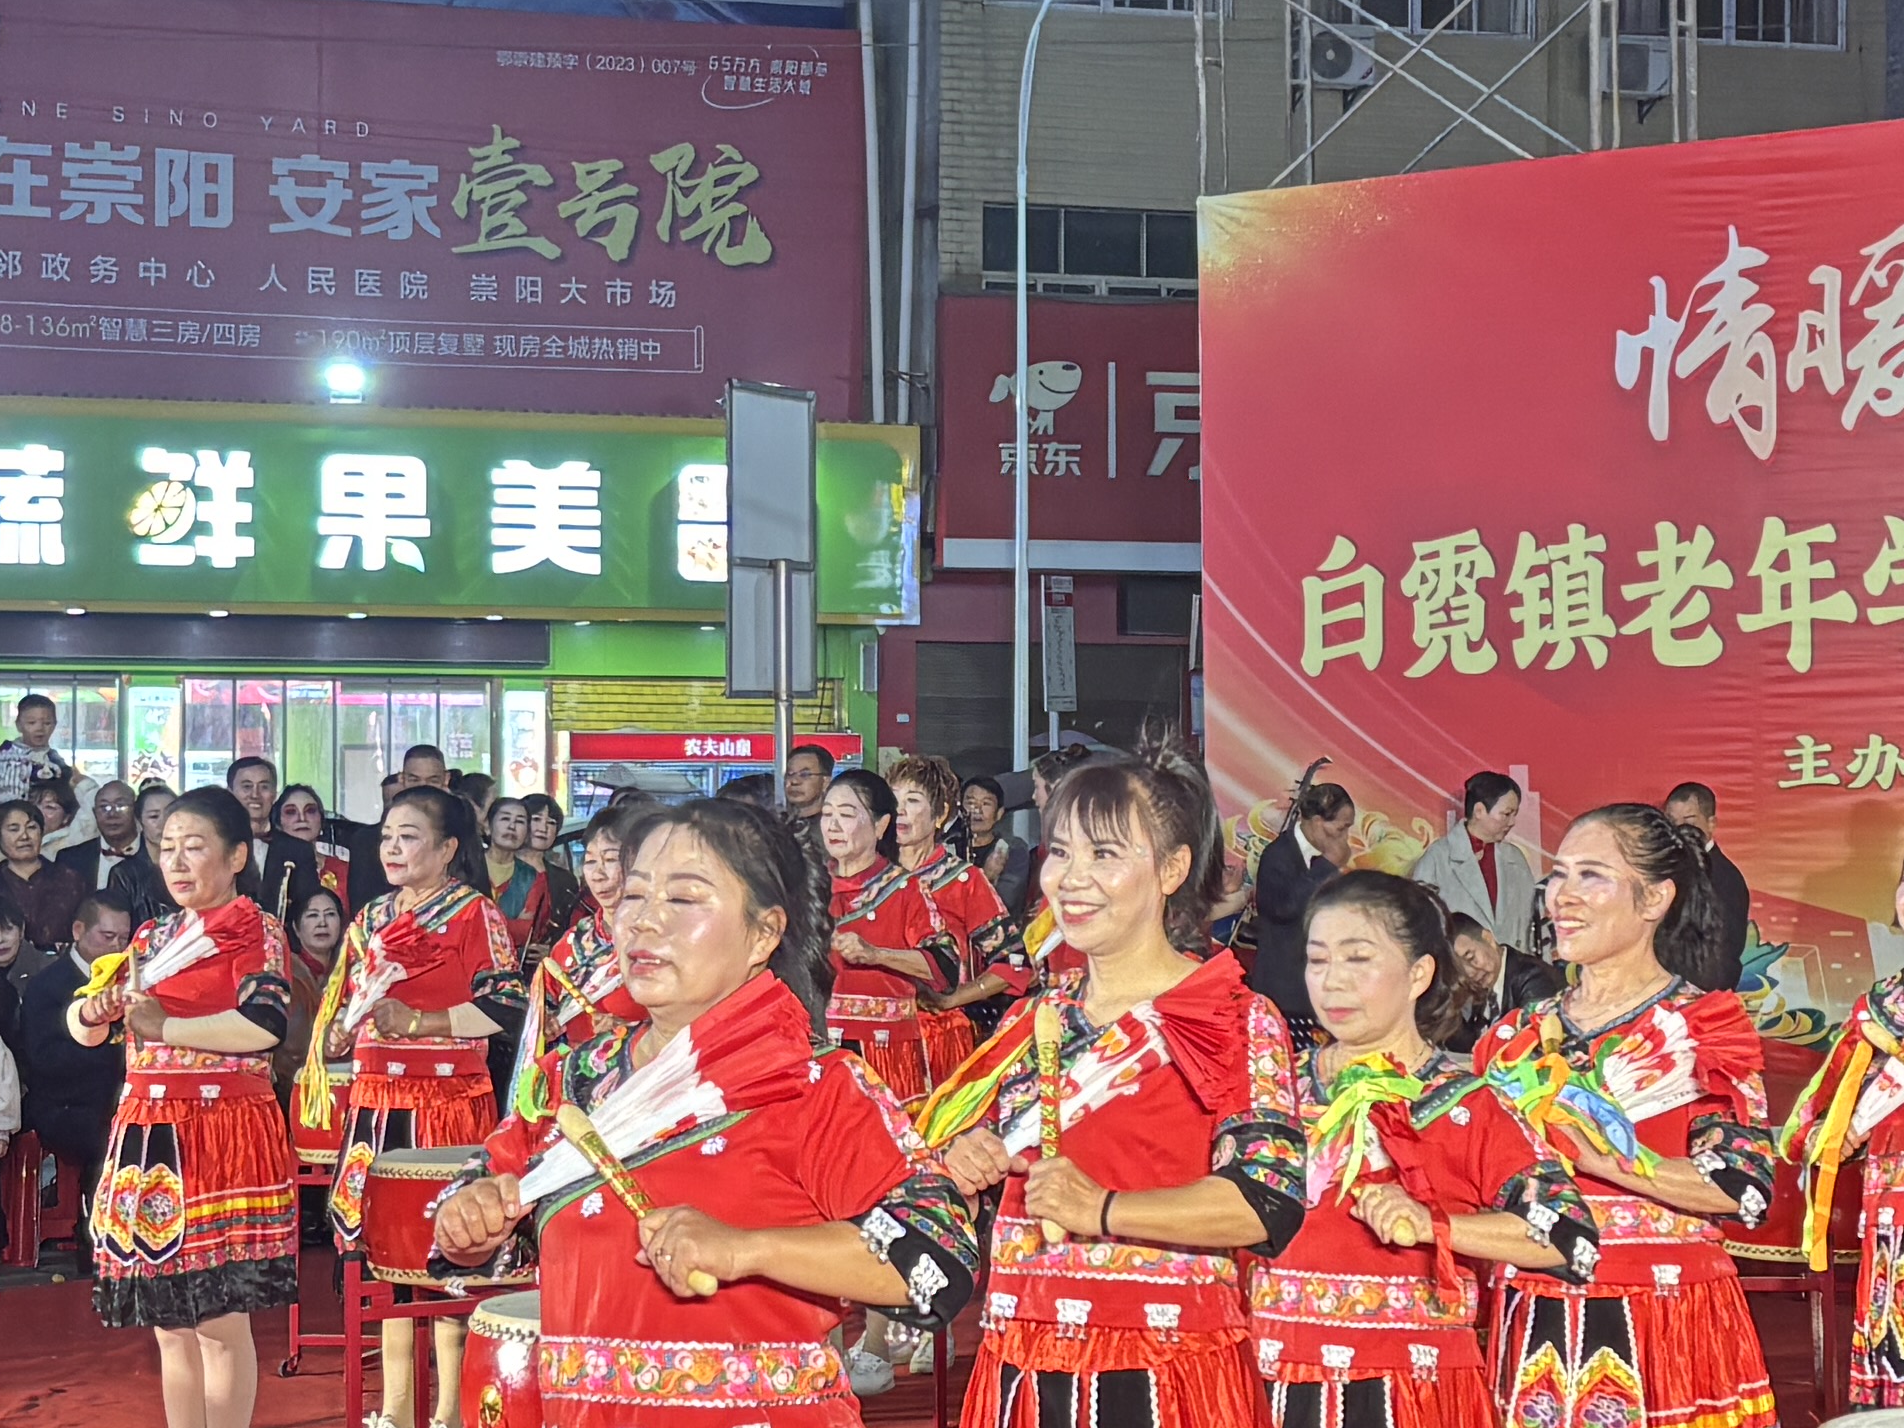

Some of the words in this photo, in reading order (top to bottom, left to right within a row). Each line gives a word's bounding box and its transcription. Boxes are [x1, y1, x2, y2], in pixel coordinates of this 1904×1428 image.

[111, 105, 218, 129] SINO
[259, 115, 370, 139] YARD
[258, 261, 430, 302] 人民医院
[469, 273, 678, 309] 崇阳大市场
[684, 737, 752, 757] 农夫山泉
